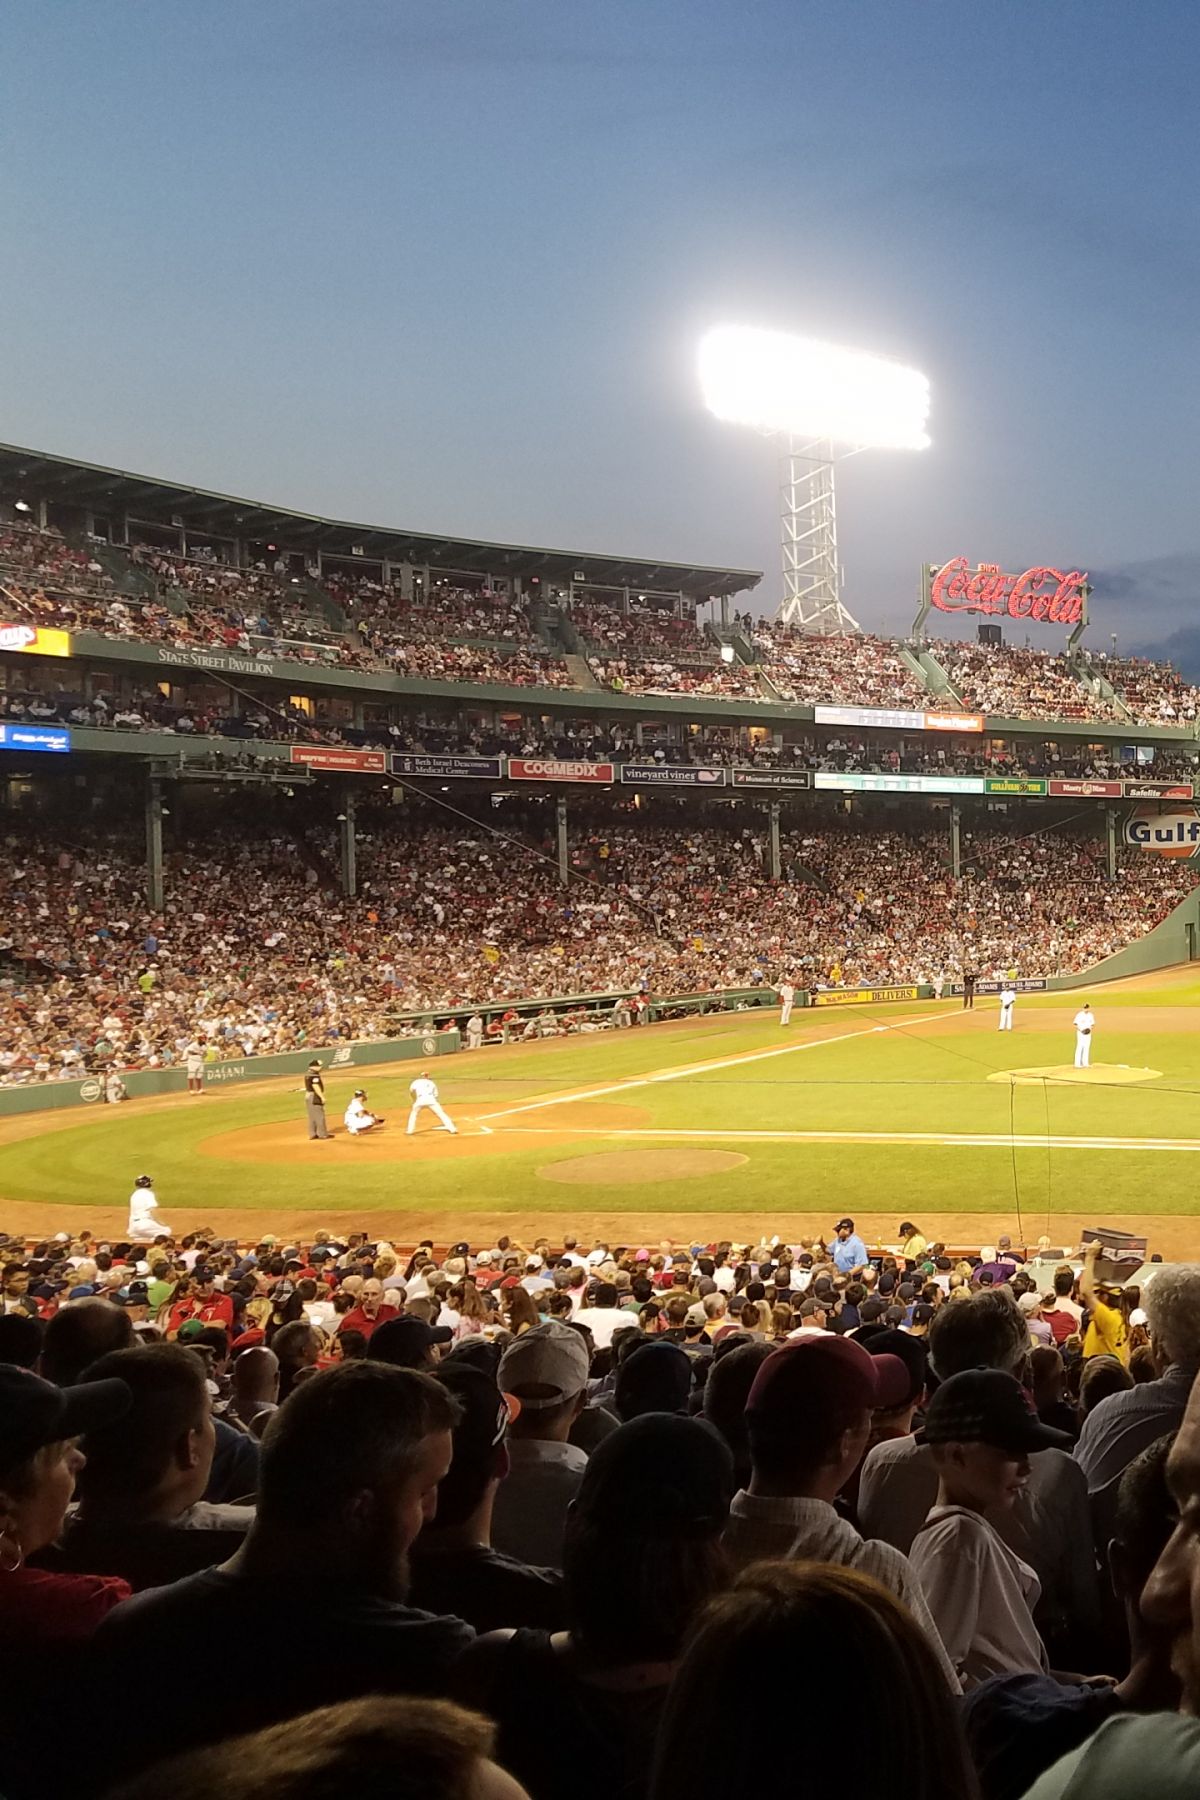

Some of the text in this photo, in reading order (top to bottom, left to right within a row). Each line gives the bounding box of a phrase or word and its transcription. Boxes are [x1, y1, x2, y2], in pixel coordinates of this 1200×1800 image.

[931, 556, 1088, 624] Coca-Cola
[159, 649, 273, 674] STATE STREET PAVILION
[523, 762, 598, 776] COGMEDIX
[626, 769, 695, 780] vineyard vines
[1129, 821, 1200, 842] Gulf
